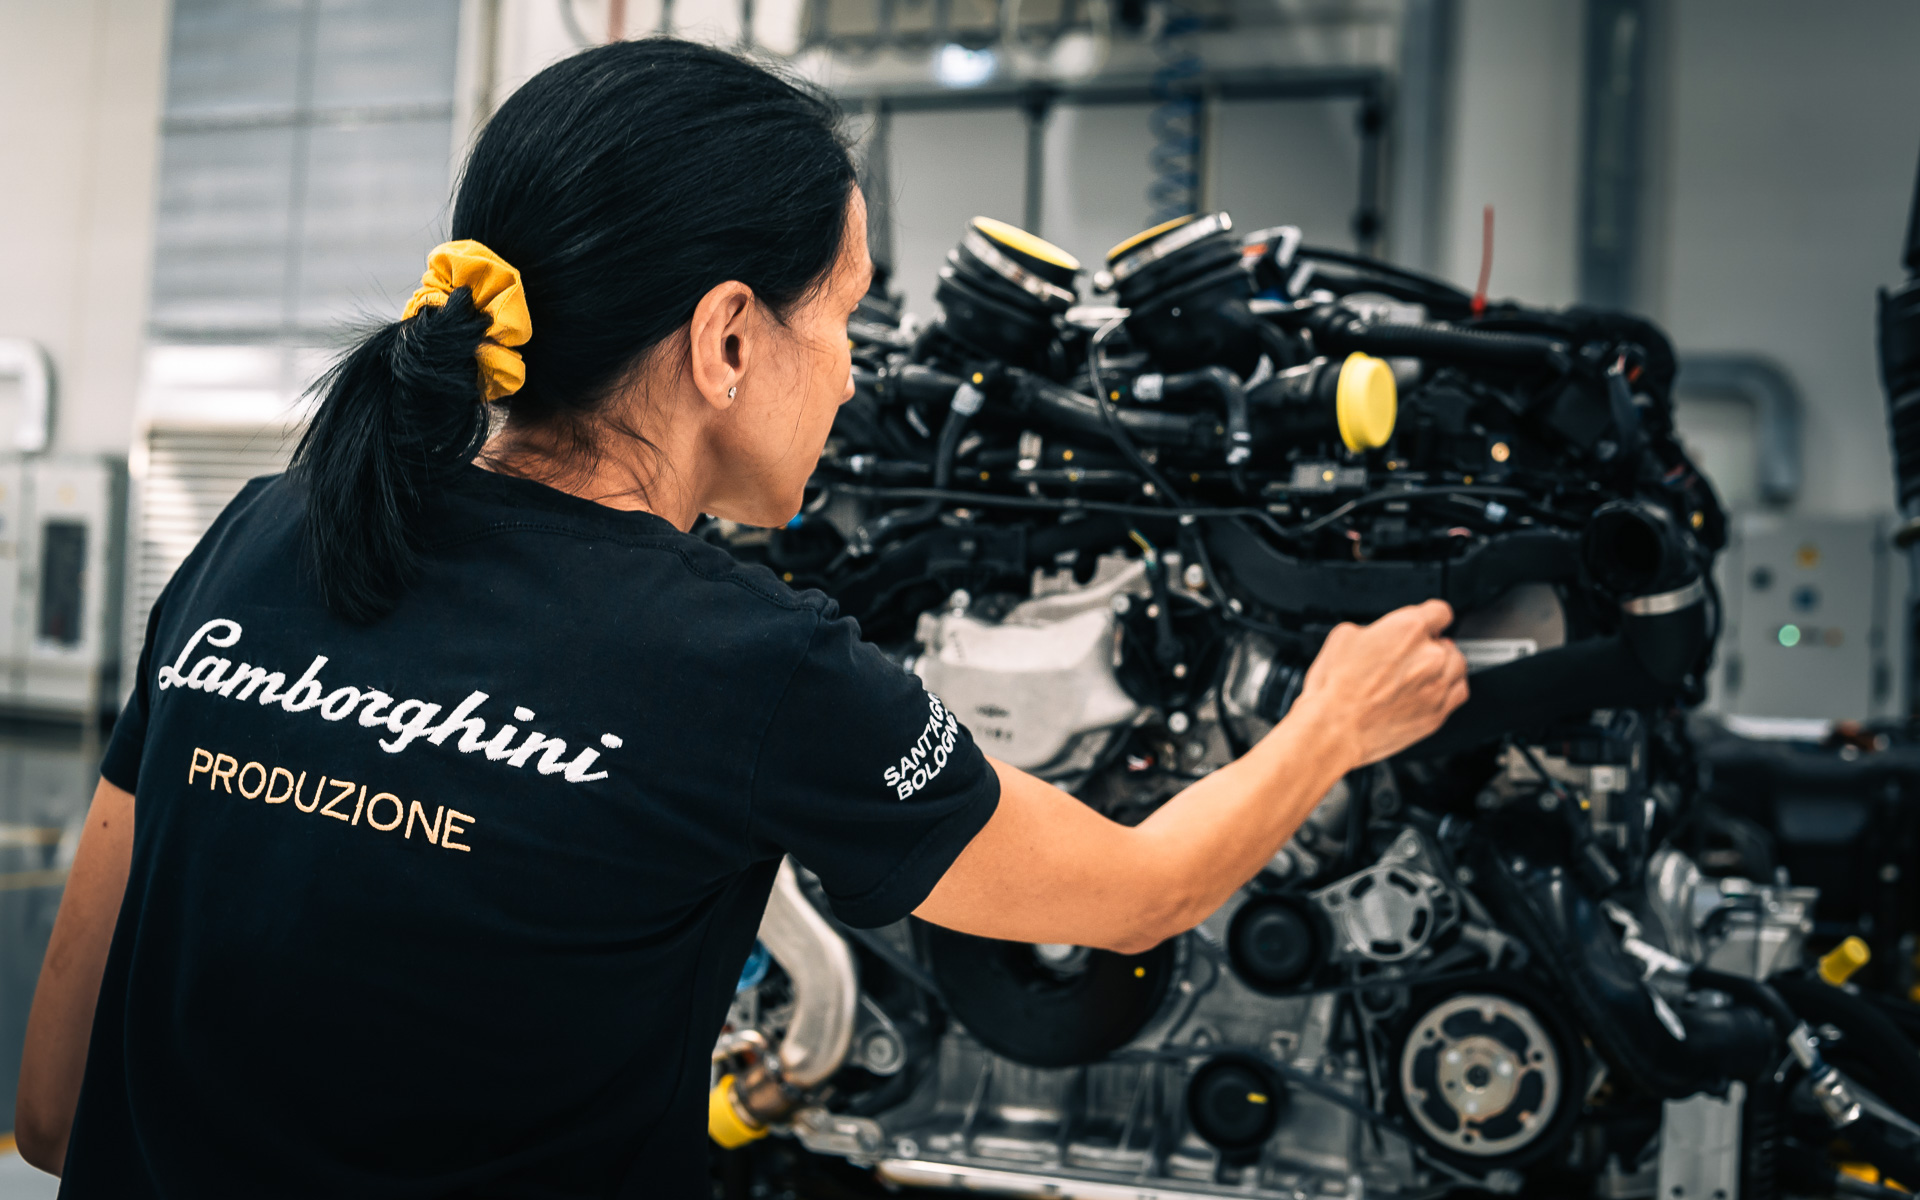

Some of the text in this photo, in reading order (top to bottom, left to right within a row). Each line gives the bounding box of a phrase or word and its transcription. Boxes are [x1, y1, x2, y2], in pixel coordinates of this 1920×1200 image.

[158, 618, 623, 783] Lamborghini
[188, 747, 476, 852] PRODUZIONE
[896, 709, 959, 801] BOLOGN
